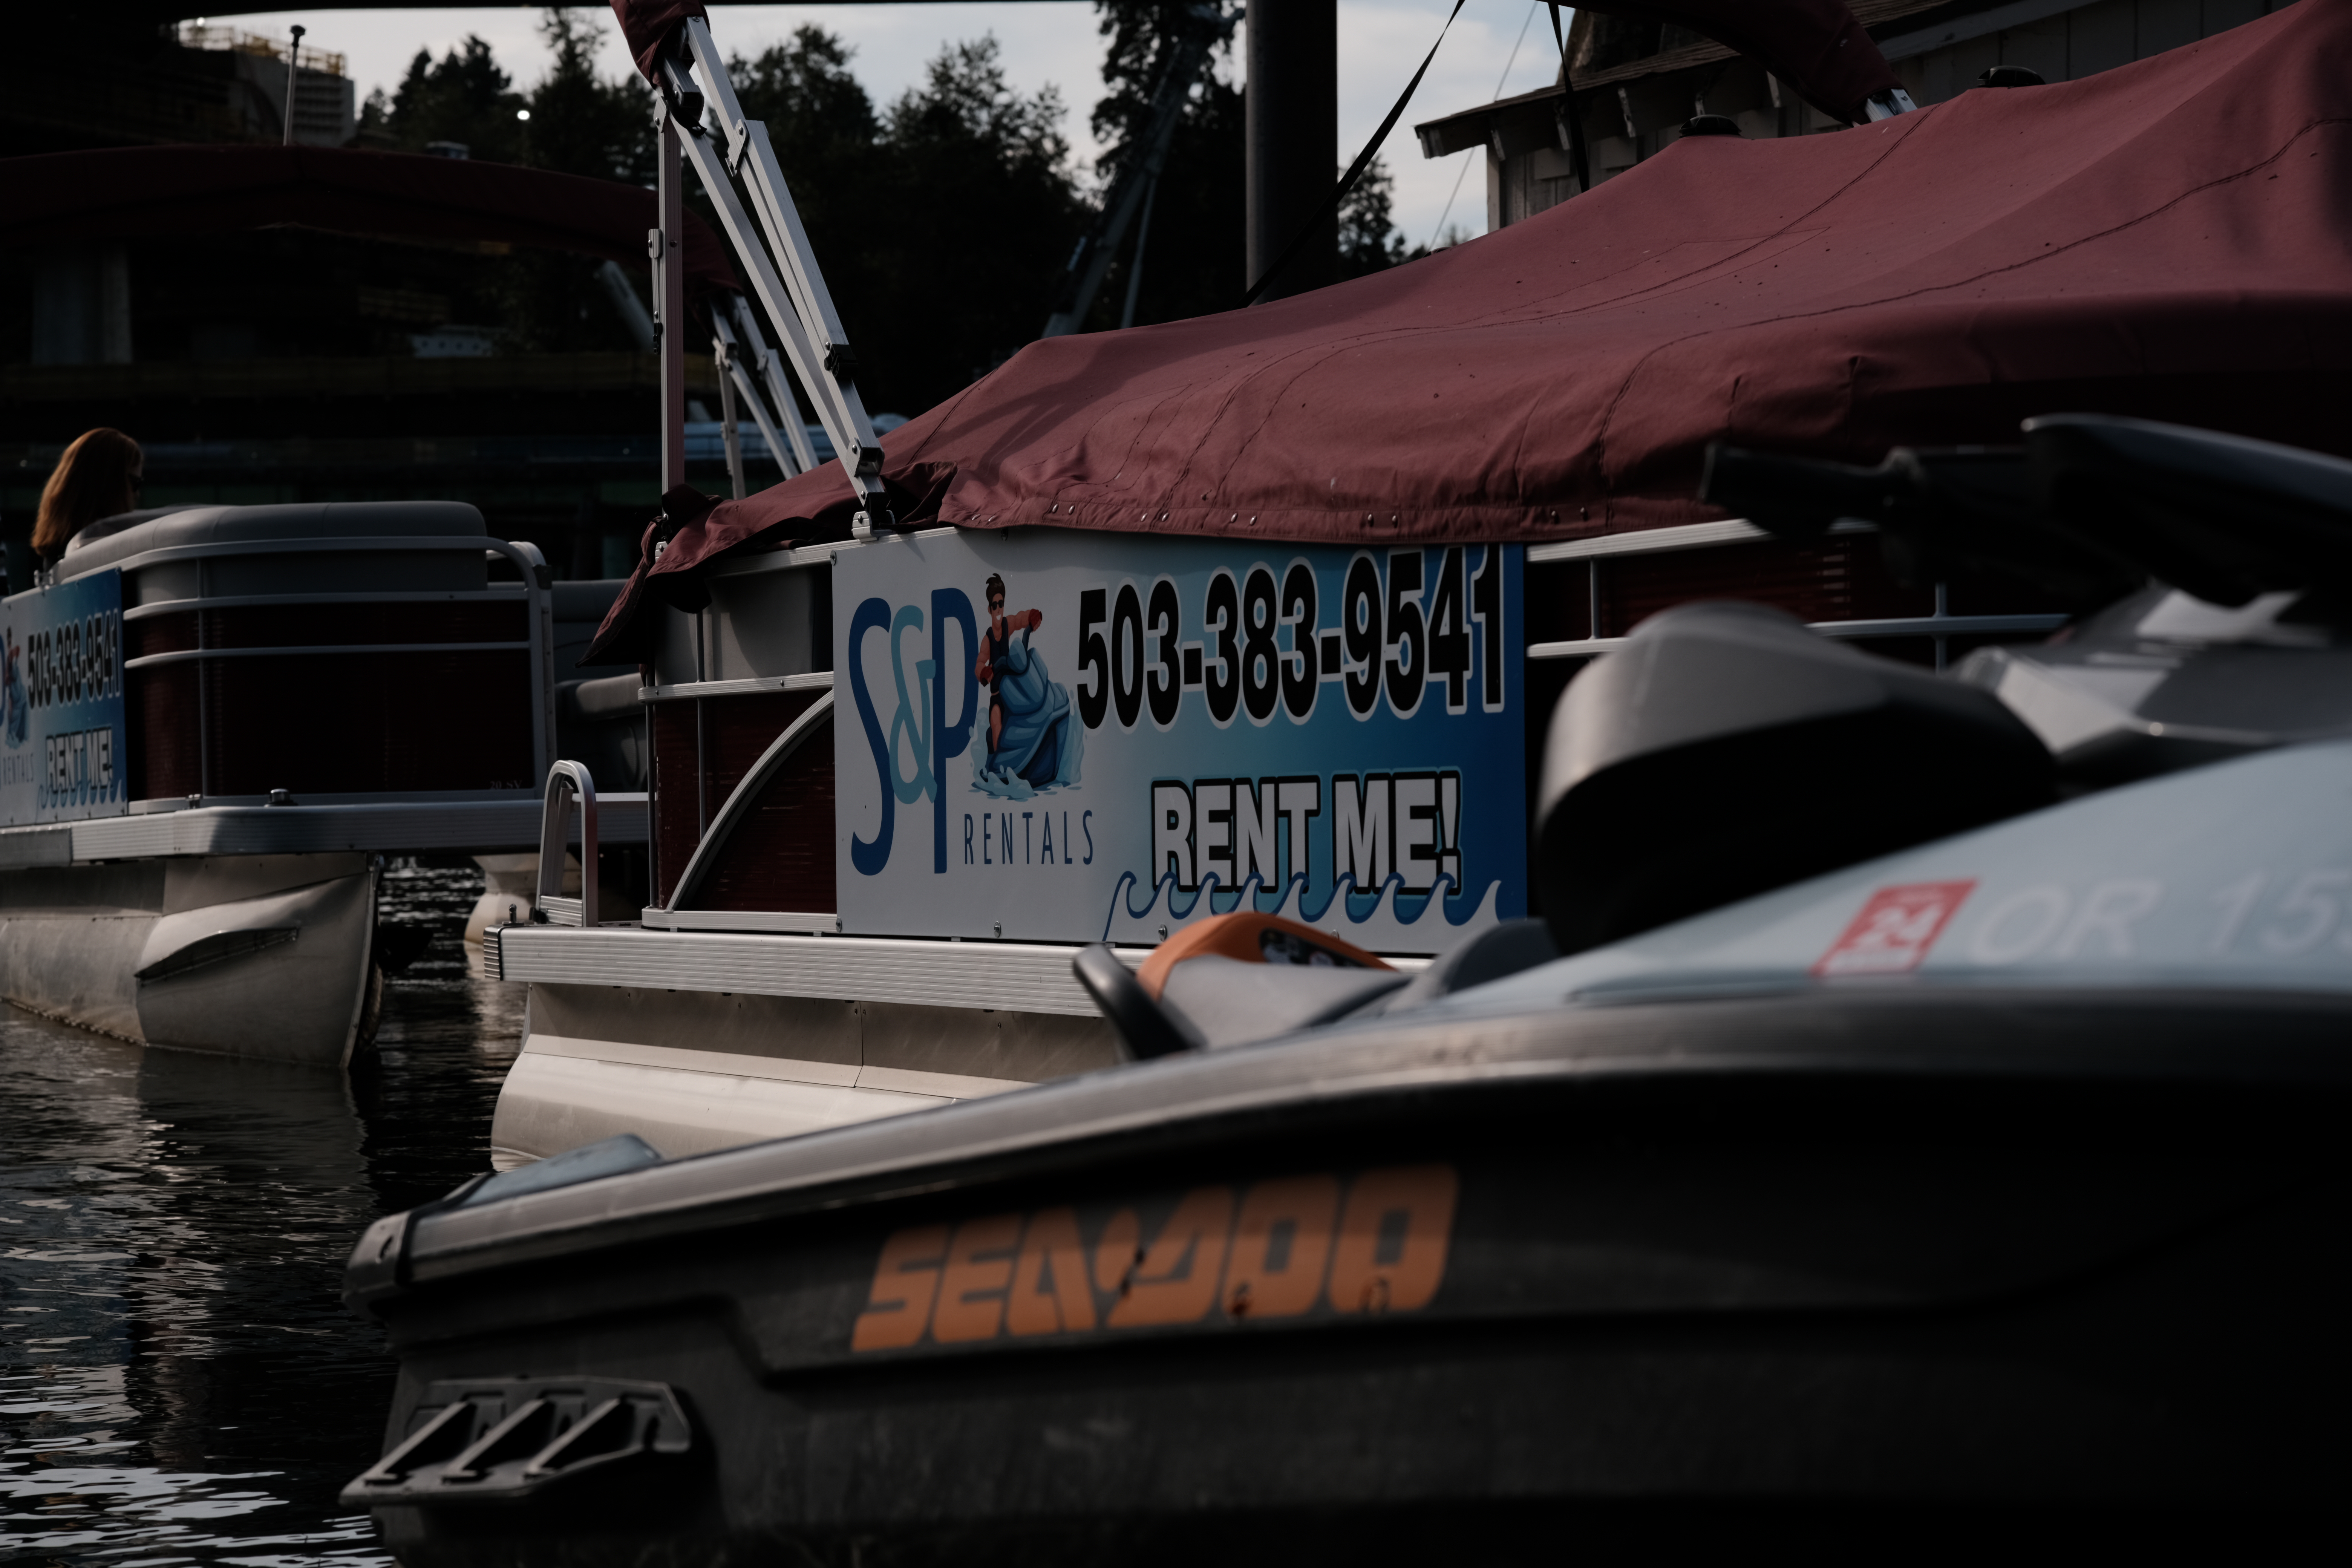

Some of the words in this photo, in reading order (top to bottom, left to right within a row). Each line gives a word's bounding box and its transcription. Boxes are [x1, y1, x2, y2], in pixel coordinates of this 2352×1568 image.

[28, 608, 120, 709] 503-383-9541
[1076, 543, 1504, 730] 503-383-9541
[3, 752, 34, 785] RENTALS
[46, 732, 83, 794] RENT
[86, 727, 113, 790] ME!
[848, 587, 979, 876] S&P
[964, 810, 1093, 865] RENTALS
[1152, 774, 1320, 893] RENT
[1332, 770, 1461, 895] ME!
[1965, 878, 2164, 964] OR
[2200, 870, 2352, 959] 15
